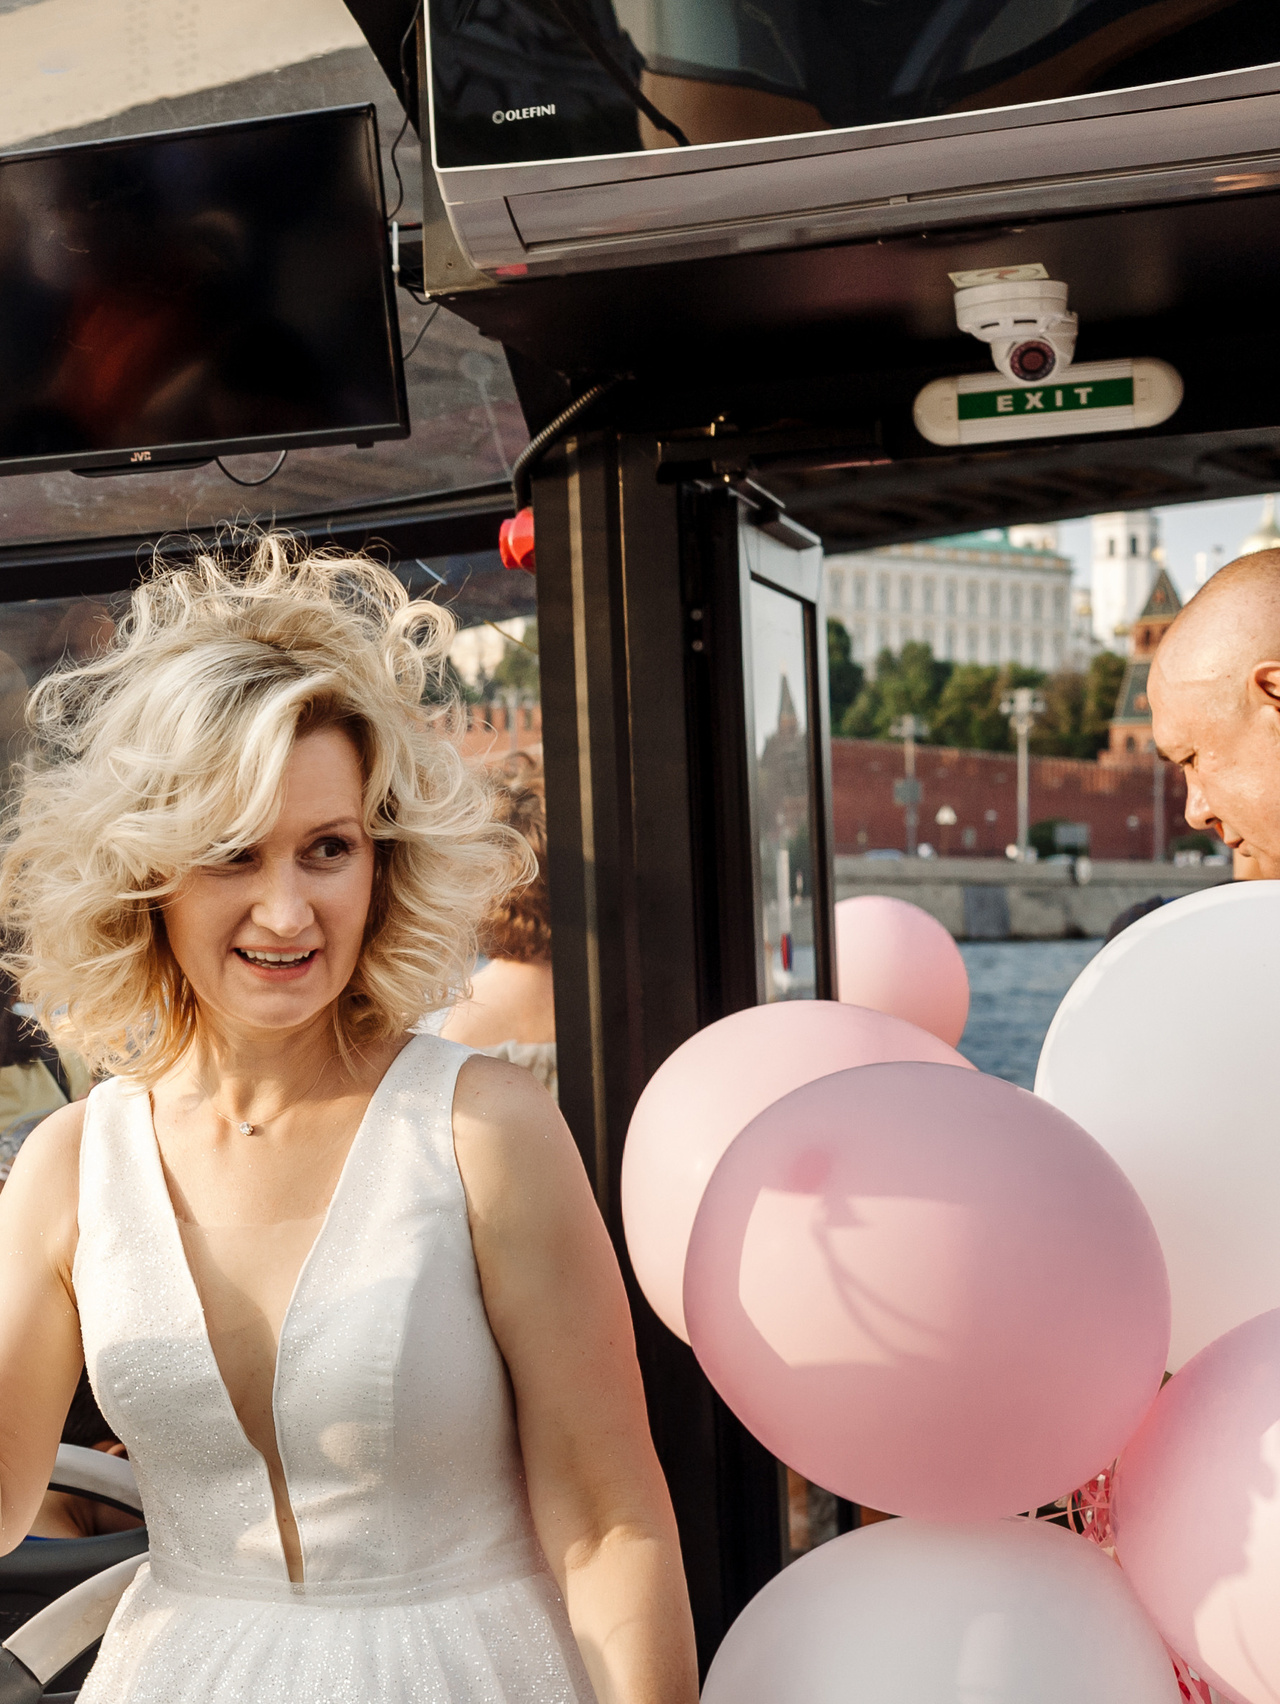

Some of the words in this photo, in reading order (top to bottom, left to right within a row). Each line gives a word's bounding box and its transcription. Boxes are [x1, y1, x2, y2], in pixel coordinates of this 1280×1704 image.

[505, 104, 556, 121] OLEFINI
[996, 387, 1093, 412] EXIT
[130, 451, 151, 462] JVC
